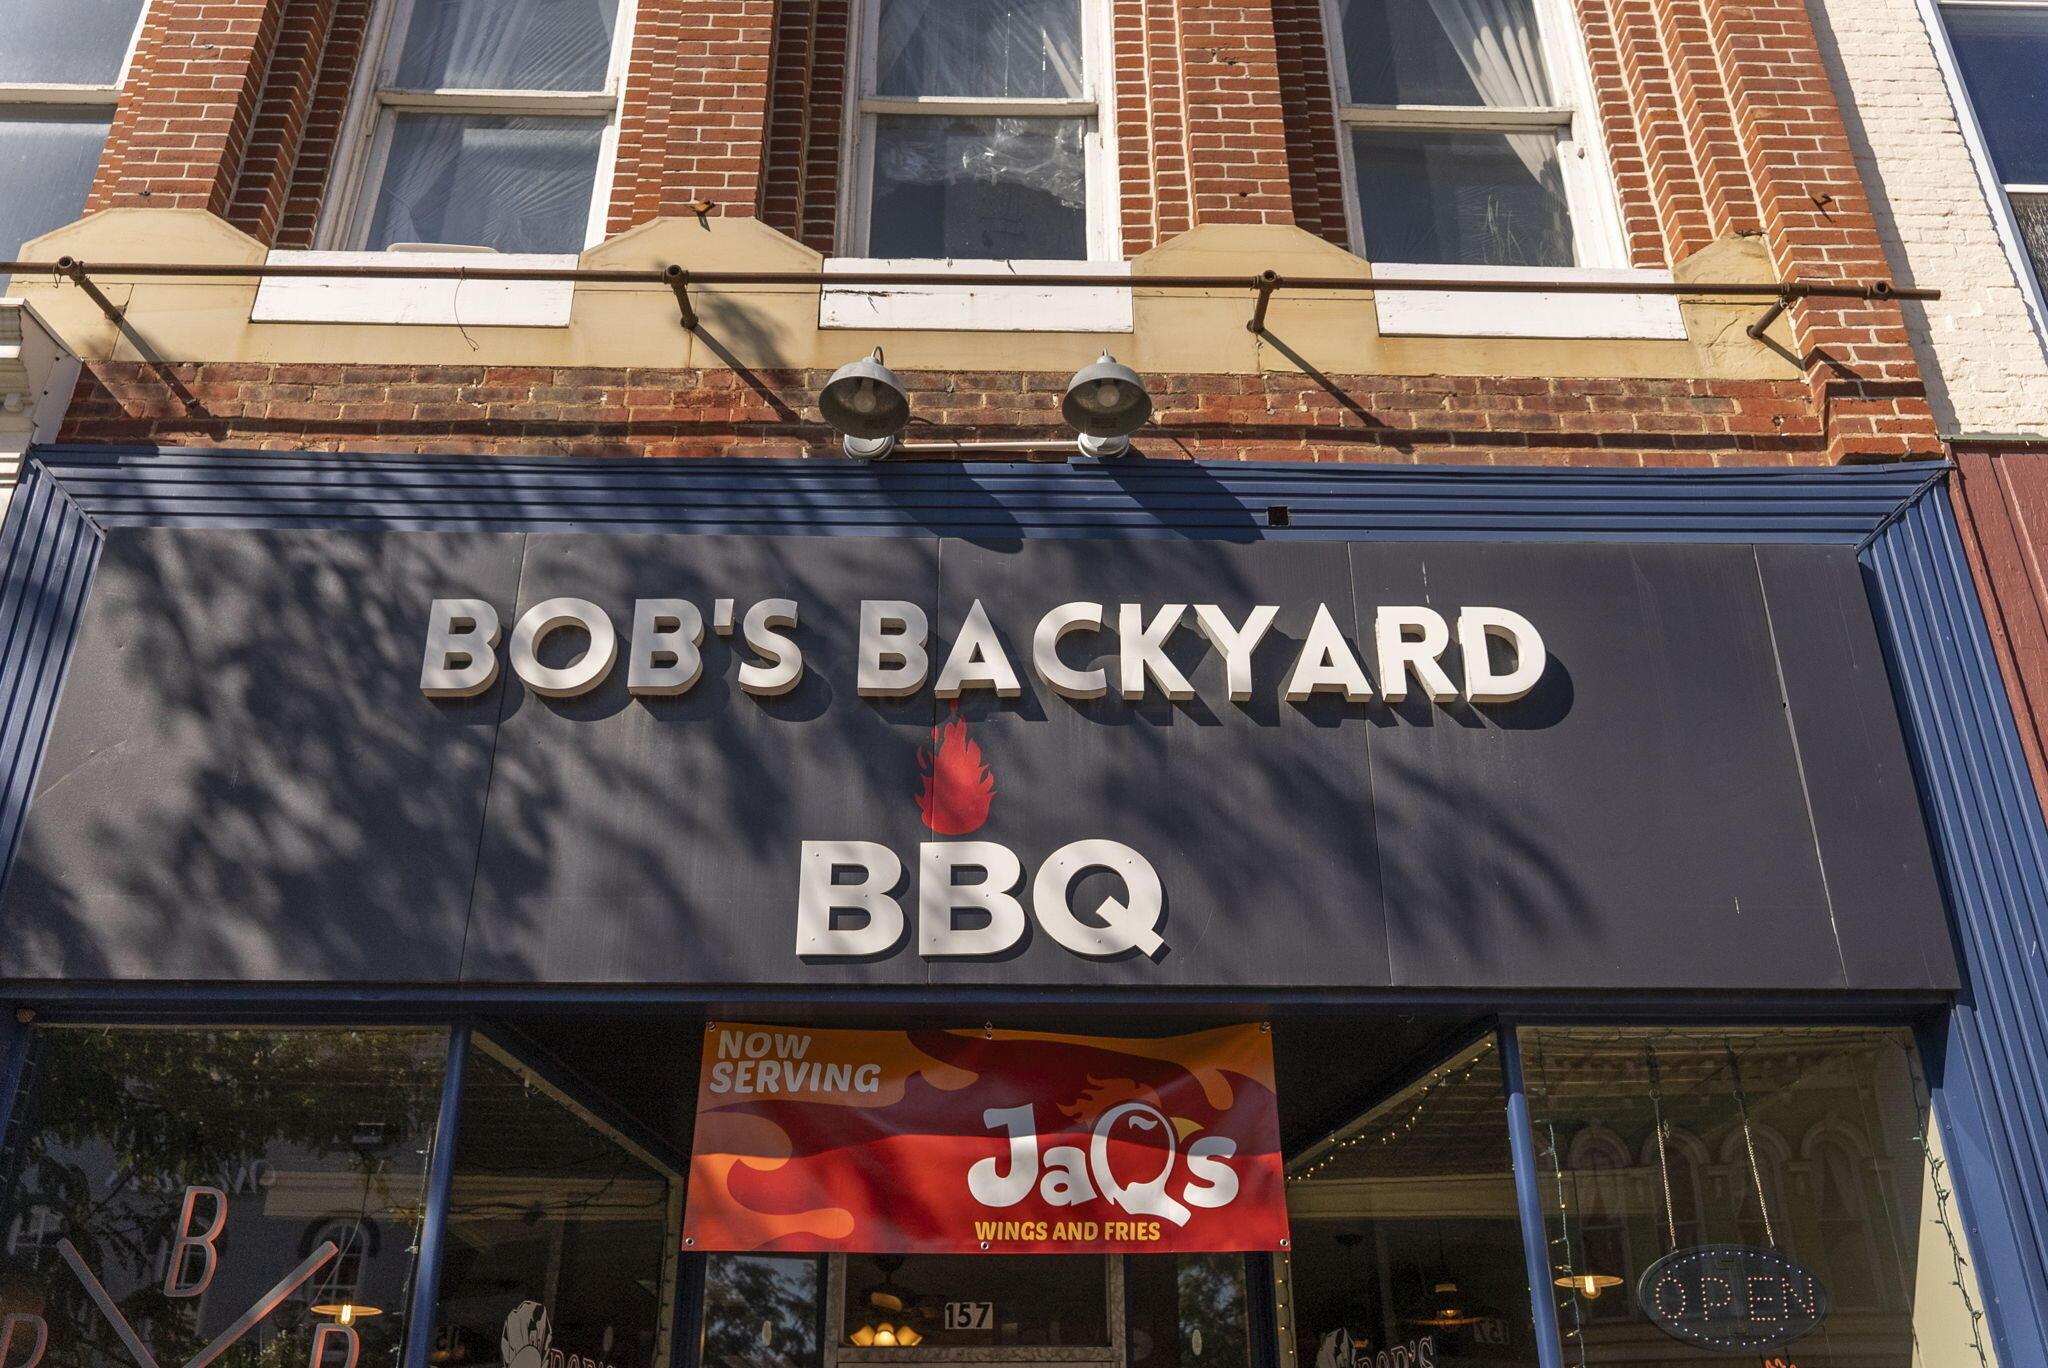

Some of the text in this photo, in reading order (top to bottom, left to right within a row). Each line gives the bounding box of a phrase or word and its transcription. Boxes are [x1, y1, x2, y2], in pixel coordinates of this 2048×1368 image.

[420, 597, 1547, 702] BOB'S BACKYARD
[796, 838, 1165, 958] BBQ
[718, 1030, 812, 1059] NOW
[709, 1060, 881, 1093] SERVING
[974, 1221, 1161, 1241] WINGS AND FRIES
[945, 1303, 990, 1328] 157
[1656, 1277, 1816, 1321] OPEN
